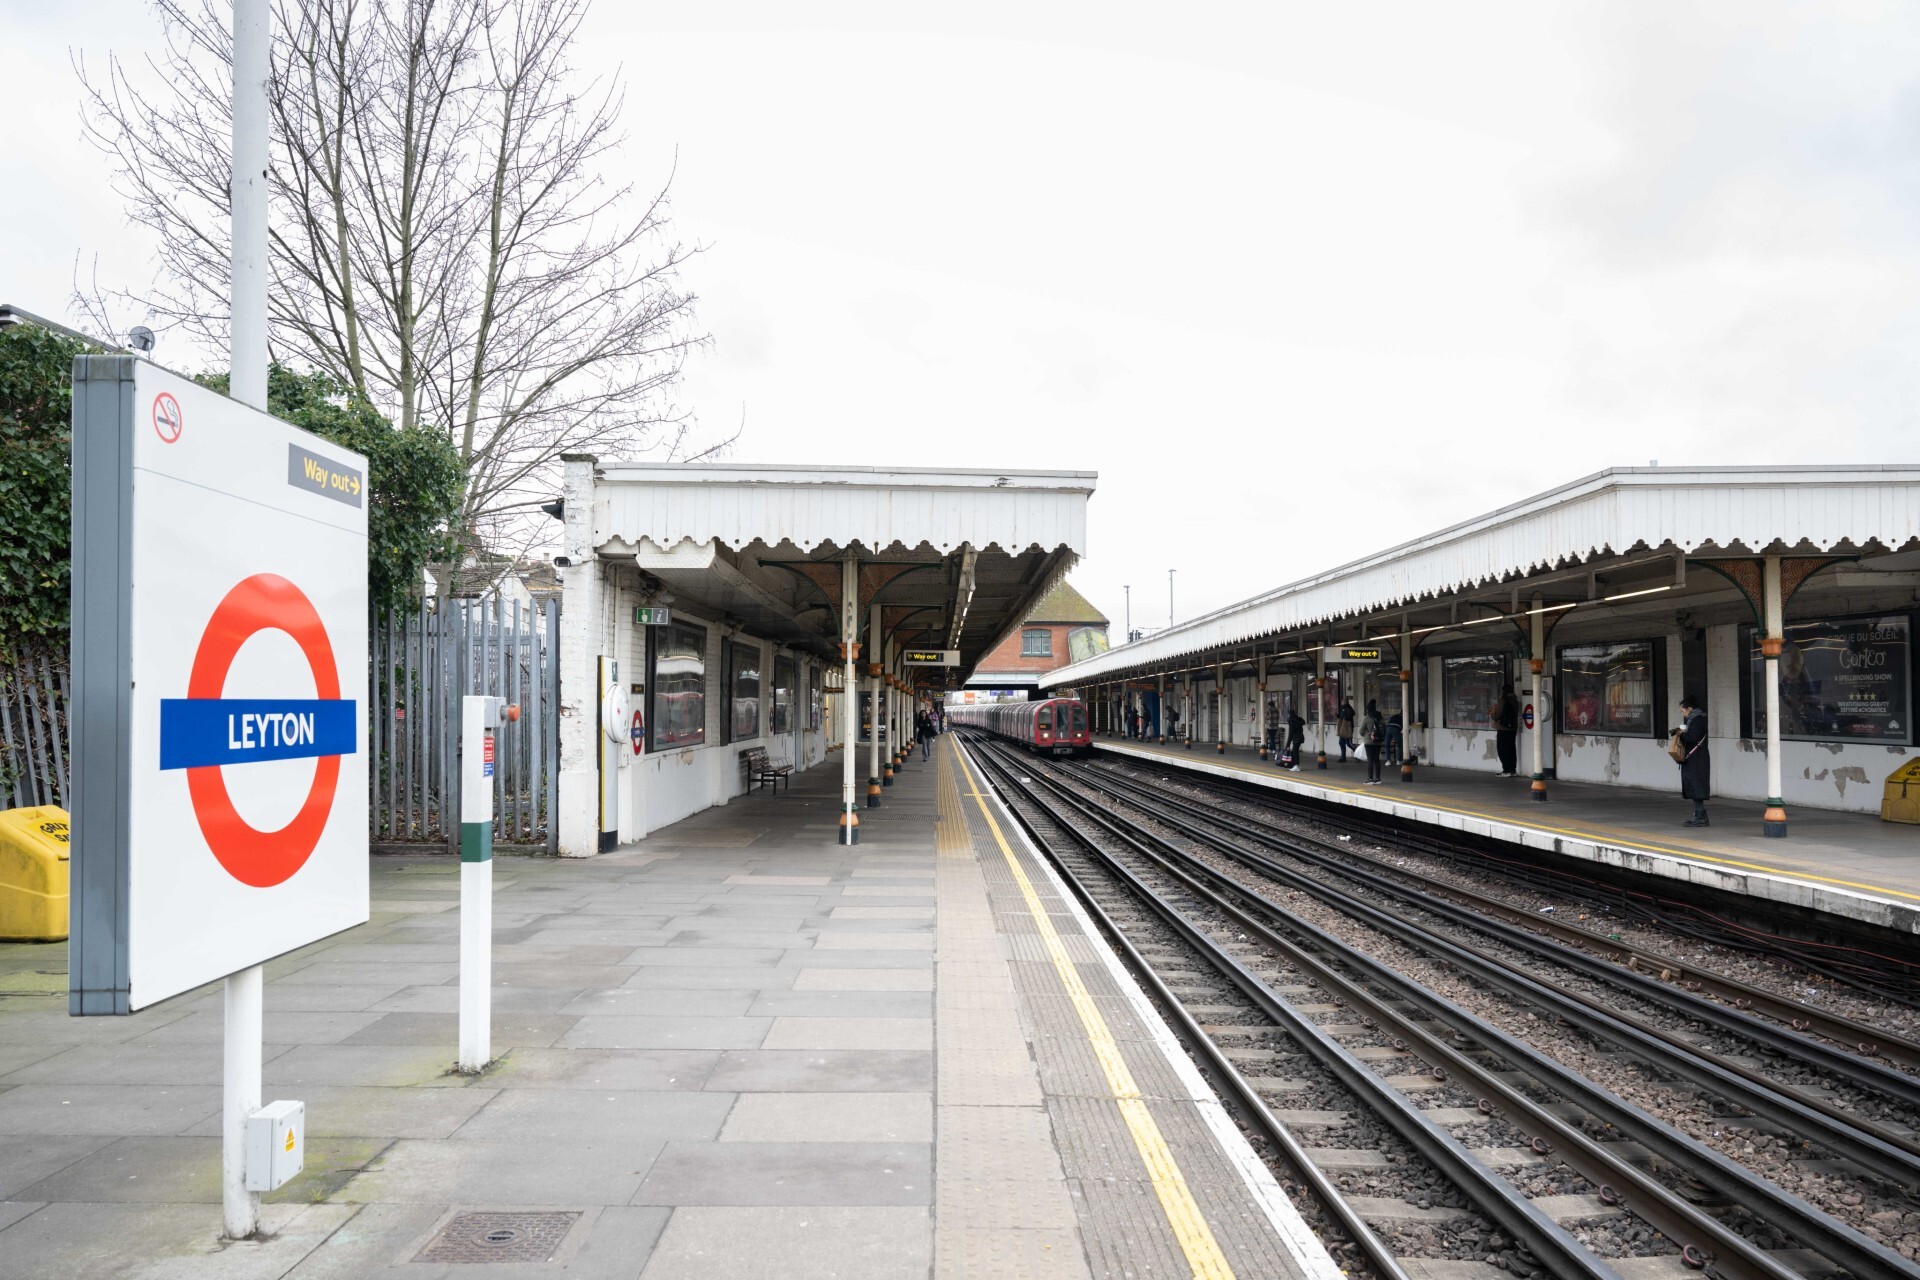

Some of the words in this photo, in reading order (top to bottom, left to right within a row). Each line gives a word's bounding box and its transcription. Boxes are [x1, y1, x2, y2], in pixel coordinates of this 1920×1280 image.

[304, 457, 329, 488] Way
[331, 473, 350, 493] out
[1856, 632, 1868, 642] DU
[1869, 630, 1898, 640] SOLEIL
[229, 712, 314, 750] LEYTON
[40, 822, 69, 834] GRIT
